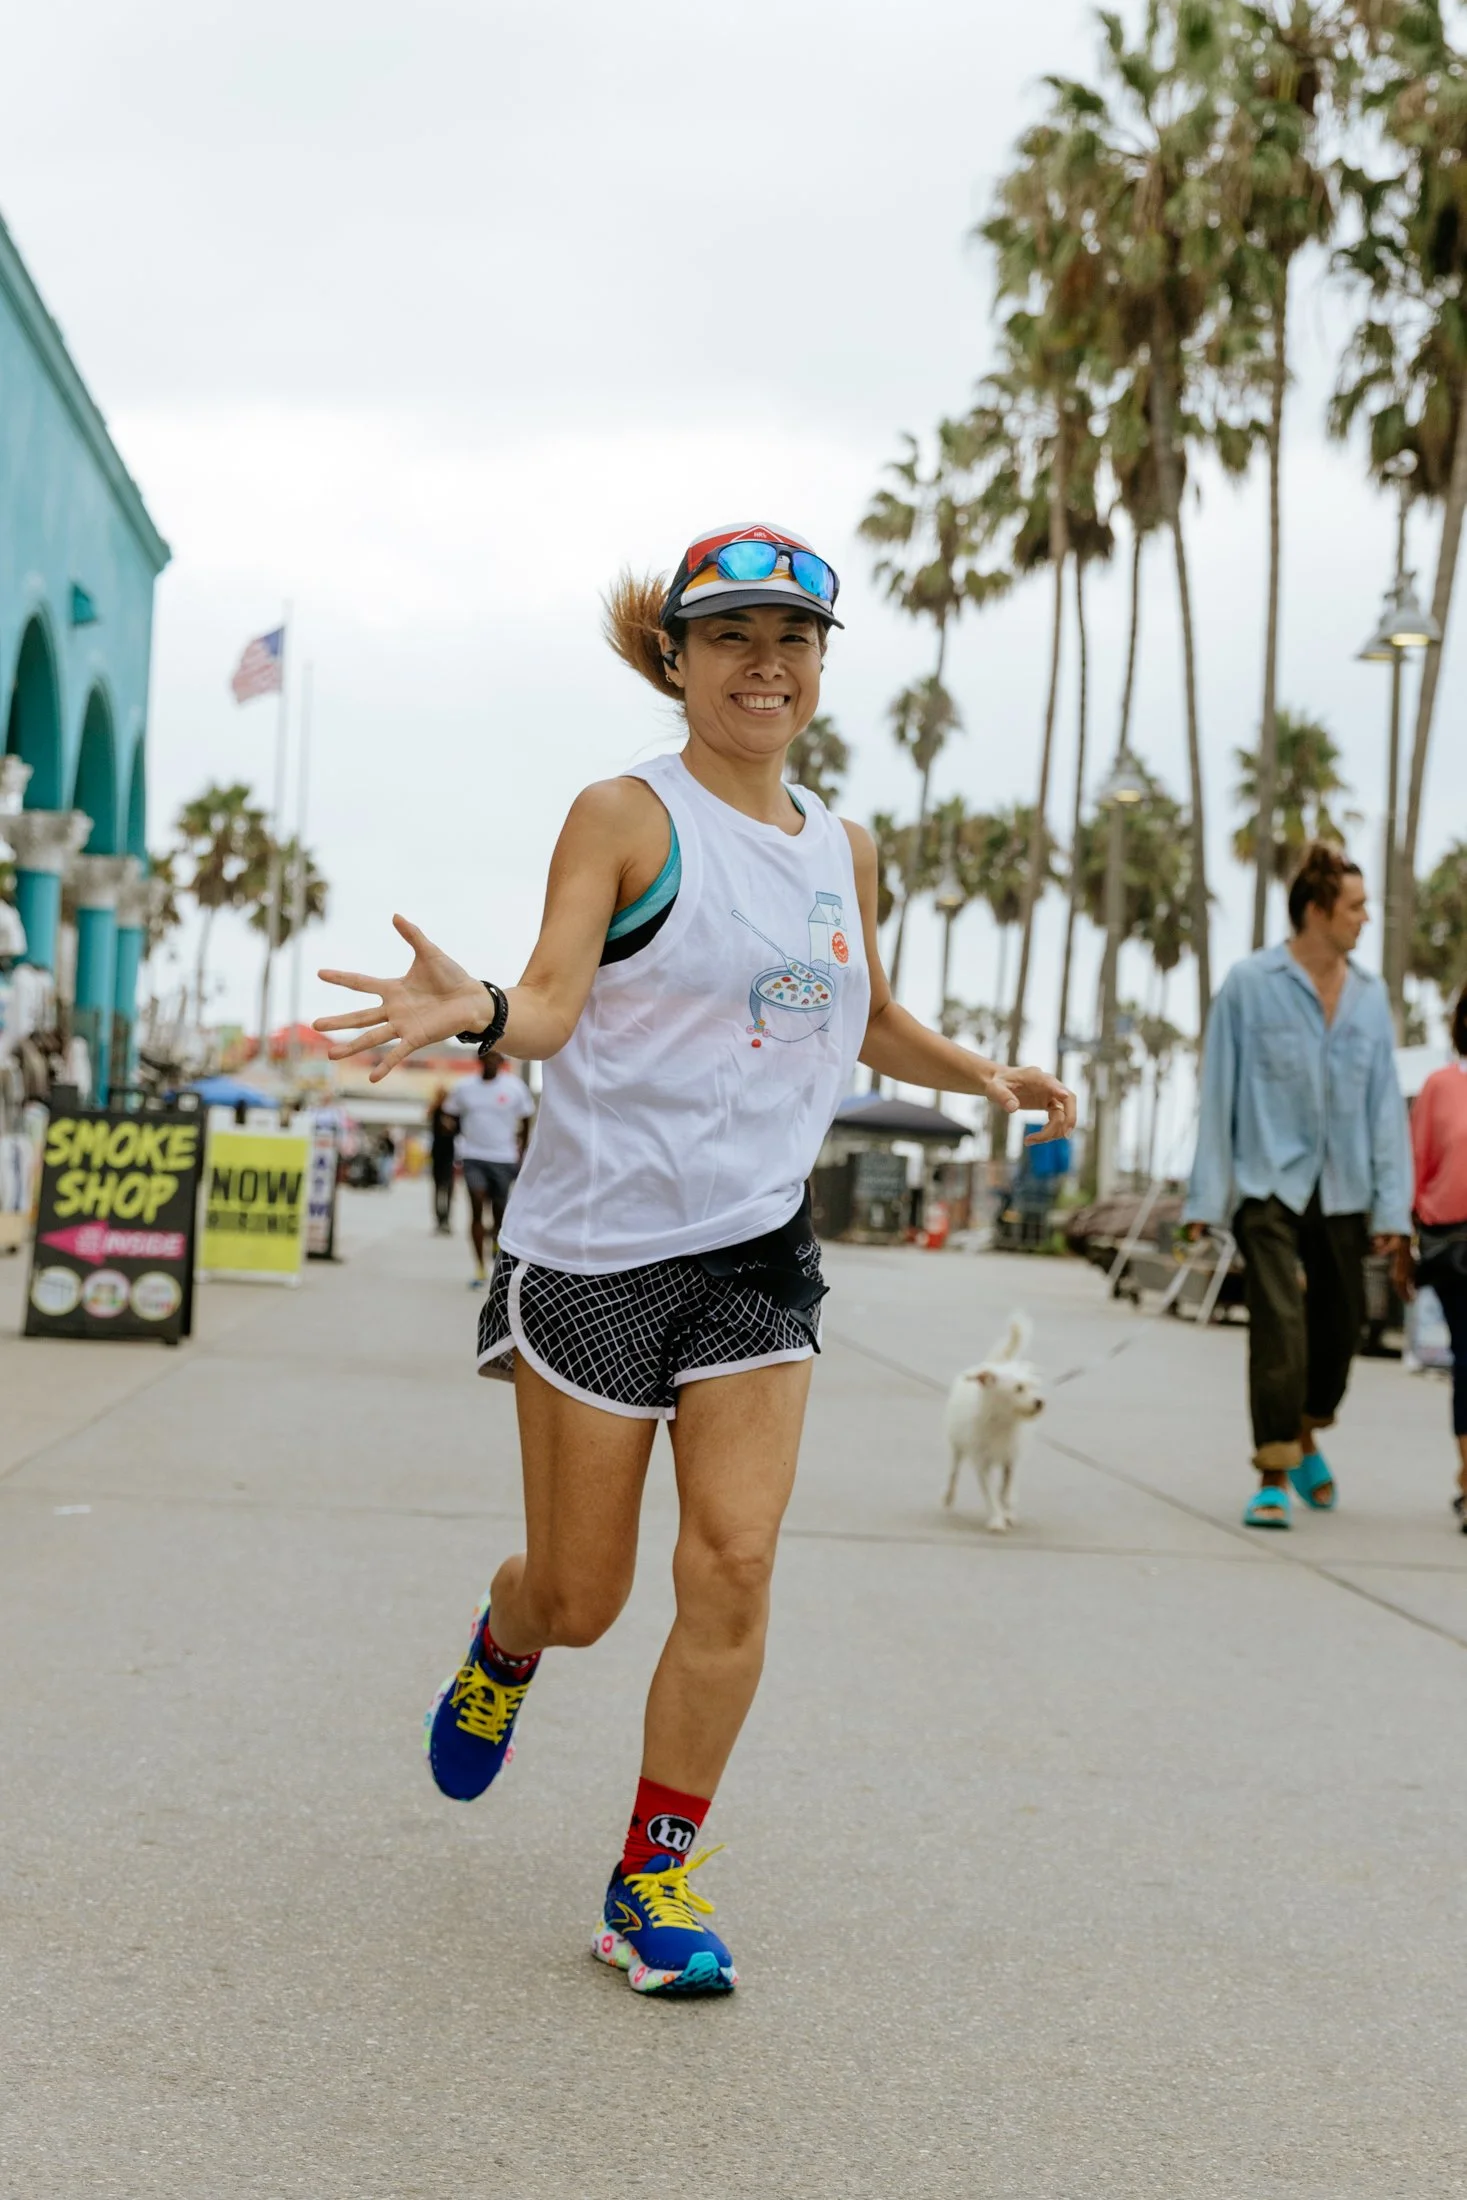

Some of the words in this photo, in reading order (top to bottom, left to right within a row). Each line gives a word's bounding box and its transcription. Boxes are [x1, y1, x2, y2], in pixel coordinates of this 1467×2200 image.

[45, 1117, 198, 1171] SMOKE
[53, 1168, 179, 1224] SHOP
[206, 1168, 303, 1204] NOW
